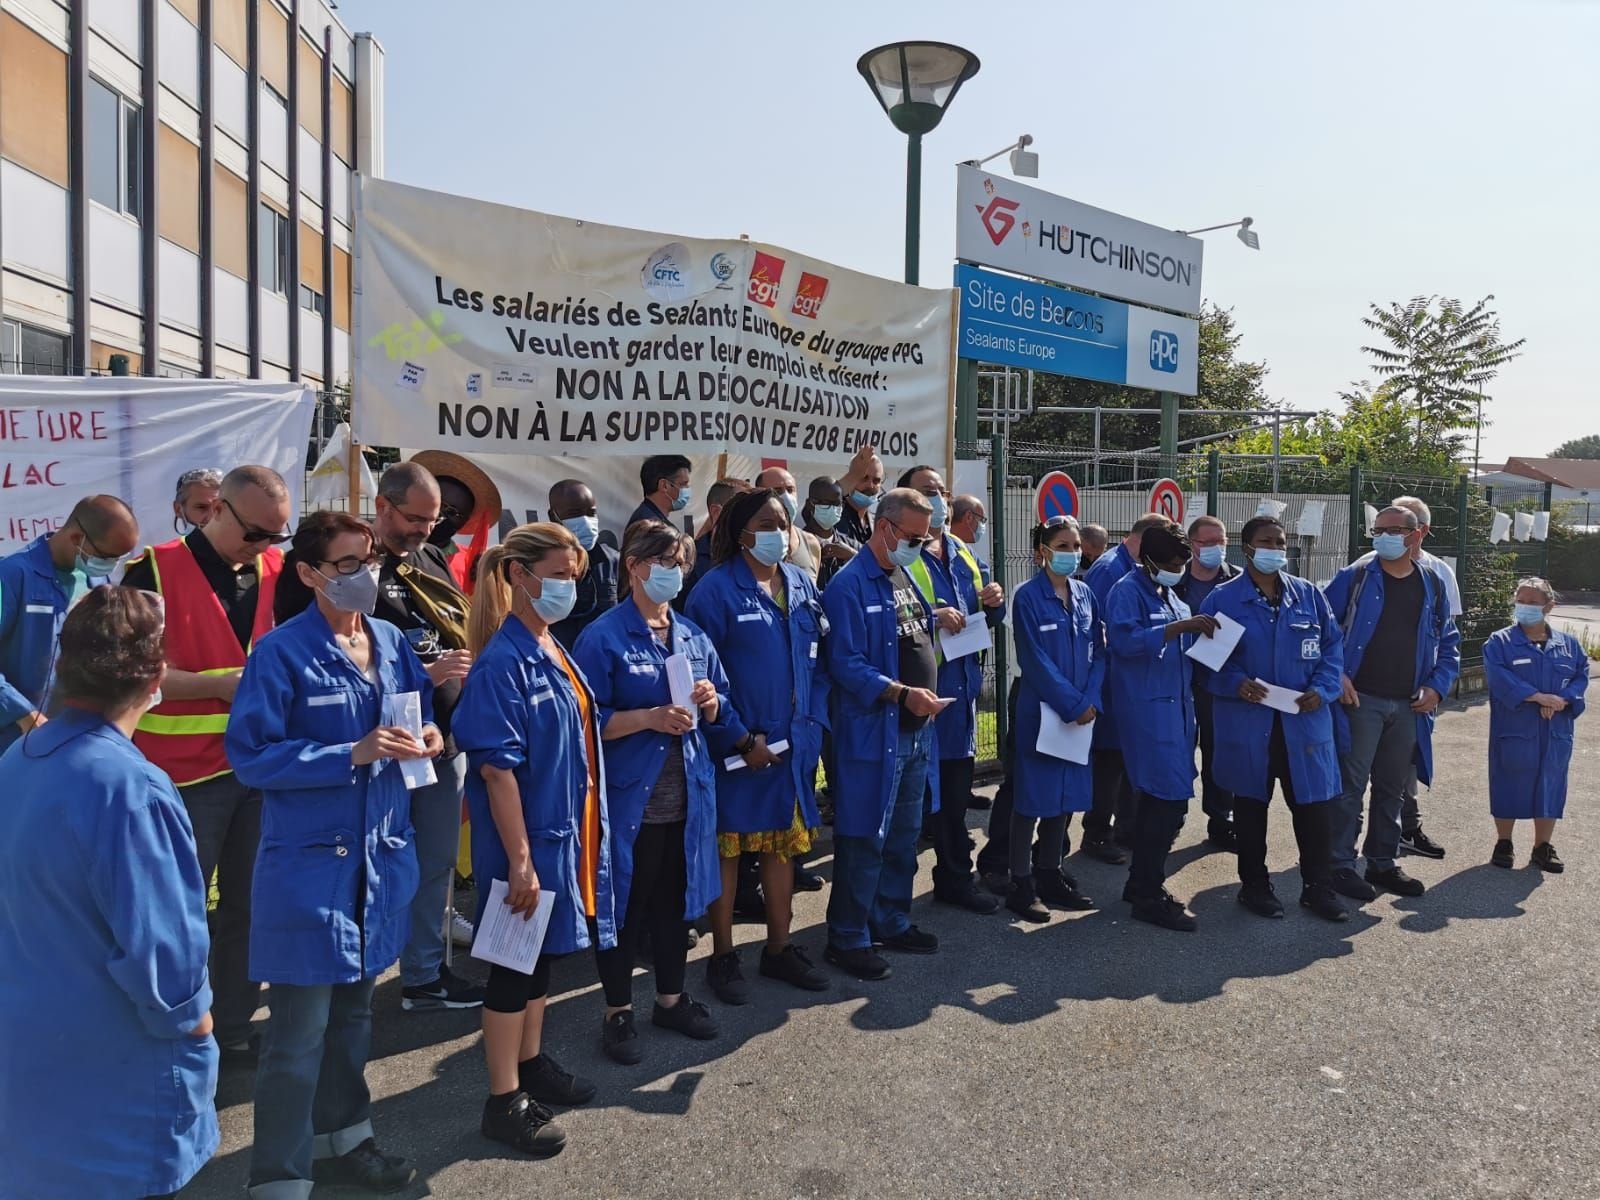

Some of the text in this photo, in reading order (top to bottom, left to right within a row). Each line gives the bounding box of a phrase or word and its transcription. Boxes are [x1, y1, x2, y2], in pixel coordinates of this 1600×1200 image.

[1039, 220, 1191, 286] HUTCHINSON
[654, 269, 680, 281] CFTC
[748, 278, 779, 303] cgt
[794, 295, 821, 316] cgt
[967, 280, 1007, 313] Site
[1011, 291, 1036, 319] de
[435, 276, 924, 366] Les salariés de Sealants Europe du groupe PPG
[506, 327, 620, 361] Veulent
[625, 334, 705, 368] garder
[710, 335, 743, 365] leur
[747, 348, 807, 379] emploi
[810, 366, 826, 382] et
[829, 365, 880, 391] disent
[966, 328, 1056, 360] Sealants Europe
[1151, 334, 1177, 369] PPG
[556, 367, 623, 401] NON
[632, 371, 651, 401] A
[658, 371, 691, 401] LA
[438, 402, 520, 441] NON
[527, 401, 550, 441] À
[560, 411, 597, 442] LA
[771, 418, 801, 449] DE
[802, 424, 840, 452] 208
[843, 427, 918, 457] EMPLOIS
